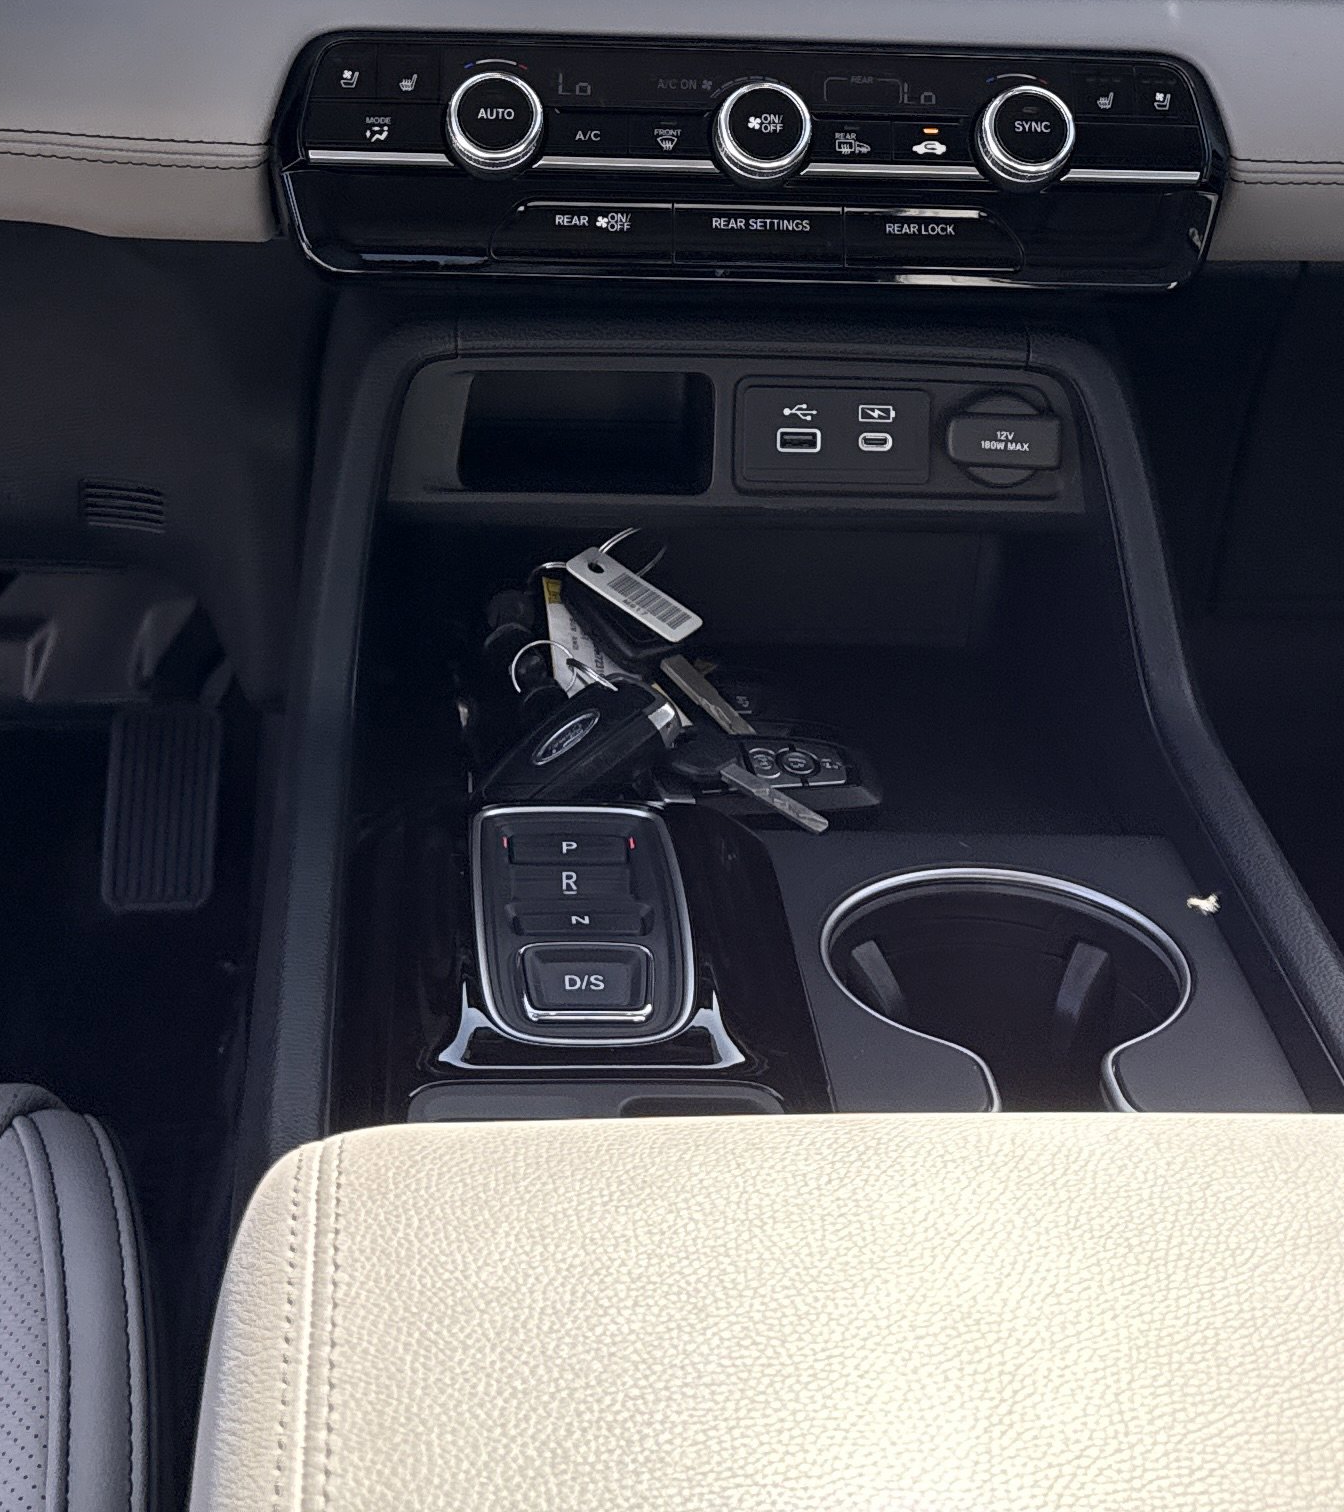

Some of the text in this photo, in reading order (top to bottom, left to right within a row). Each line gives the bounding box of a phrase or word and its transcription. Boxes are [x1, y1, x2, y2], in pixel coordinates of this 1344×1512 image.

[657, 78, 697, 90] A/C ON
[477, 108, 515, 121] AUTO
[761, 113, 783, 124] ON/
[365, 116, 392, 125] MODE
[654, 128, 682, 137] FRONT
[761, 123, 784, 134] OFF
[1014, 120, 1051, 134] SYNC
[575, 130, 601, 142] A/C
[834, 132, 857, 140] REAR
[555, 215, 589, 226] REAR
[607, 212, 632, 223] ON/
[607, 221, 632, 232] OFF
[711, 218, 811, 232] REAR SETTINGS
[885, 223, 955, 236] REAR LOCK
[996, 431, 1015, 440] 12V
[980, 440, 1030, 451] 180W MAX
[561, 841, 578, 854] P
[561, 871, 577, 890] R
[571, 915, 590, 925] N
[563, 974, 605, 991] D/S
